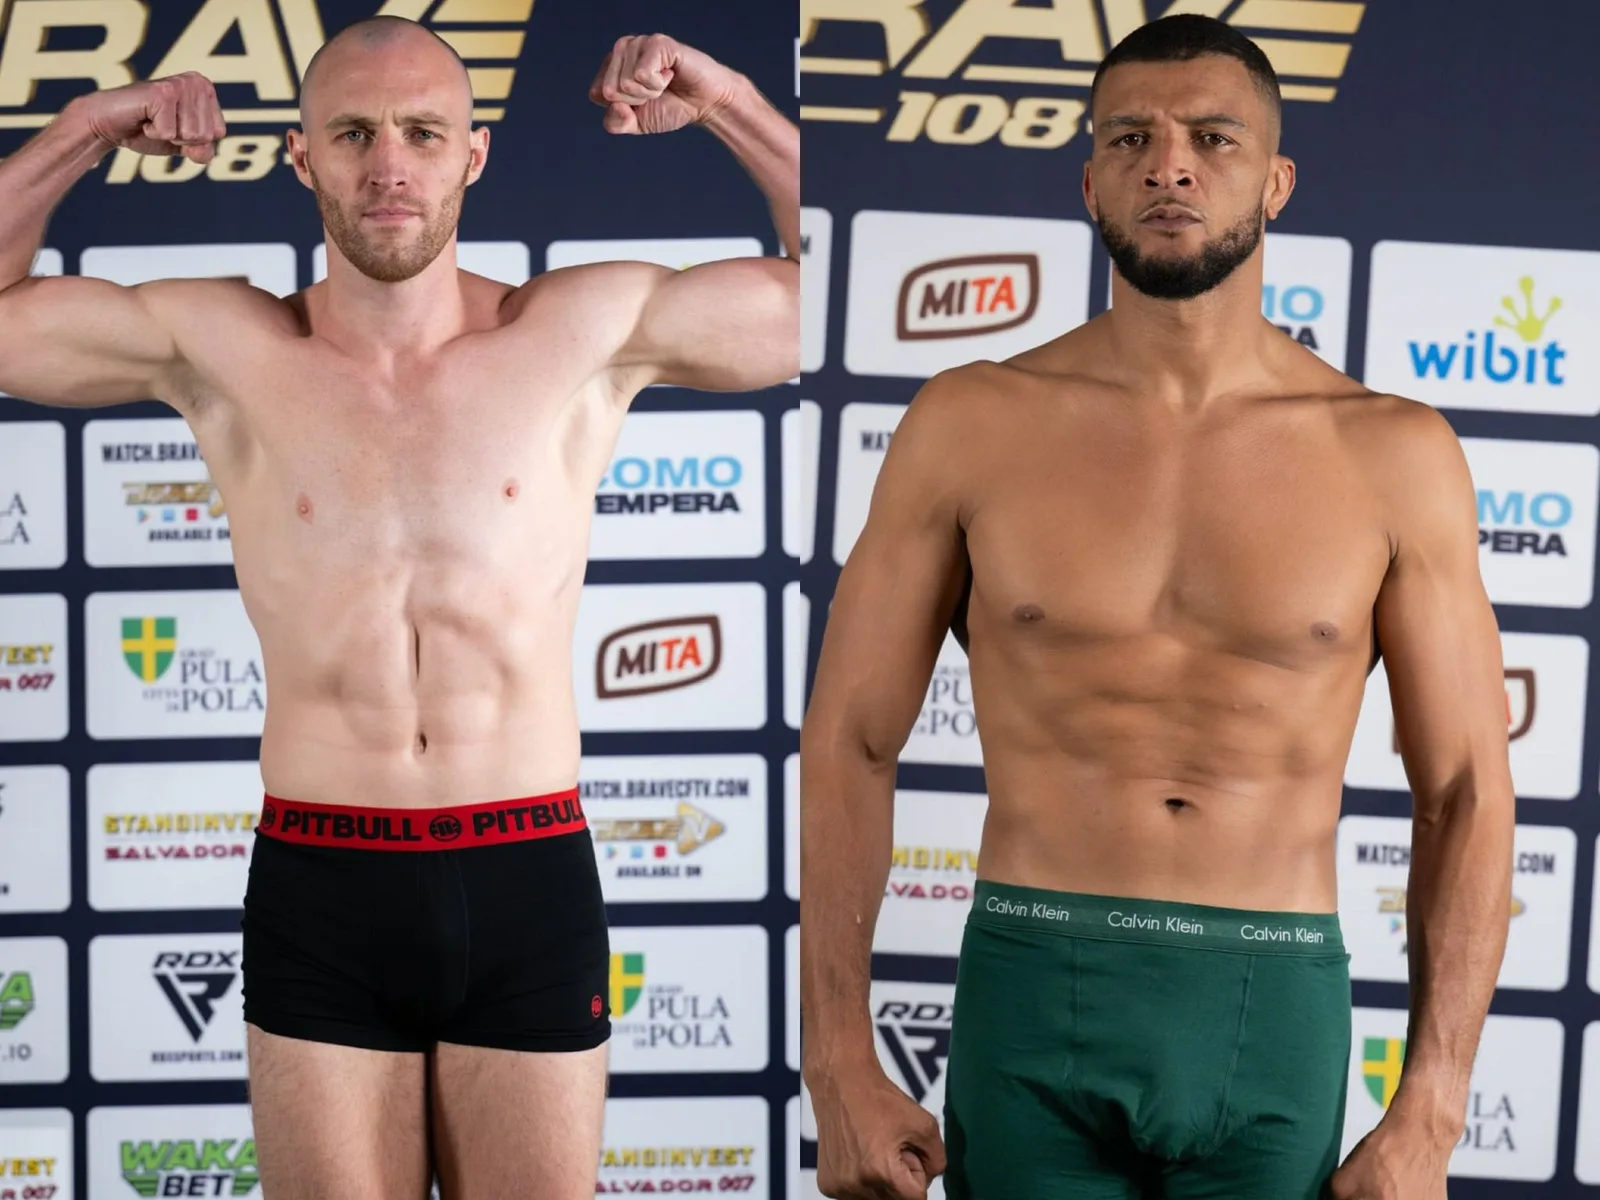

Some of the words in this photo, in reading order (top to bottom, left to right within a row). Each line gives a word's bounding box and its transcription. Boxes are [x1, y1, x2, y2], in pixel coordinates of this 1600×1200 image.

[886, 92, 1085, 149] 108
[919, 275, 1017, 319] MITA
[1408, 330, 1567, 386] wibit
[101, 442, 205, 463] WATCH.BRAV
[599, 456, 743, 489] OMO
[615, 635, 702, 680] MITA
[180, 659, 262, 684] PULA
[181, 687, 264, 712] POLA
[281, 808, 422, 841] PITBULL
[104, 844, 247, 862] SALVADOR
[986, 896, 1028, 918] Calvin
[1032, 903, 1069, 922] Klein
[1107, 911, 1160, 931] Calvin
[1165, 916, 1204, 935] Klein
[1240, 924, 1291, 942] Calvin
[1296, 927, 1324, 944] Klein
[153, 951, 240, 969] RDX
[648, 994, 729, 1019] PULA
[649, 1022, 732, 1048] POLA
[120, 1138, 257, 1171] WAKA
[600, 1147, 754, 1168] ANDINVEST
[163, 1174, 231, 1197] BET
[595, 1179, 713, 1194] ALVADOR
